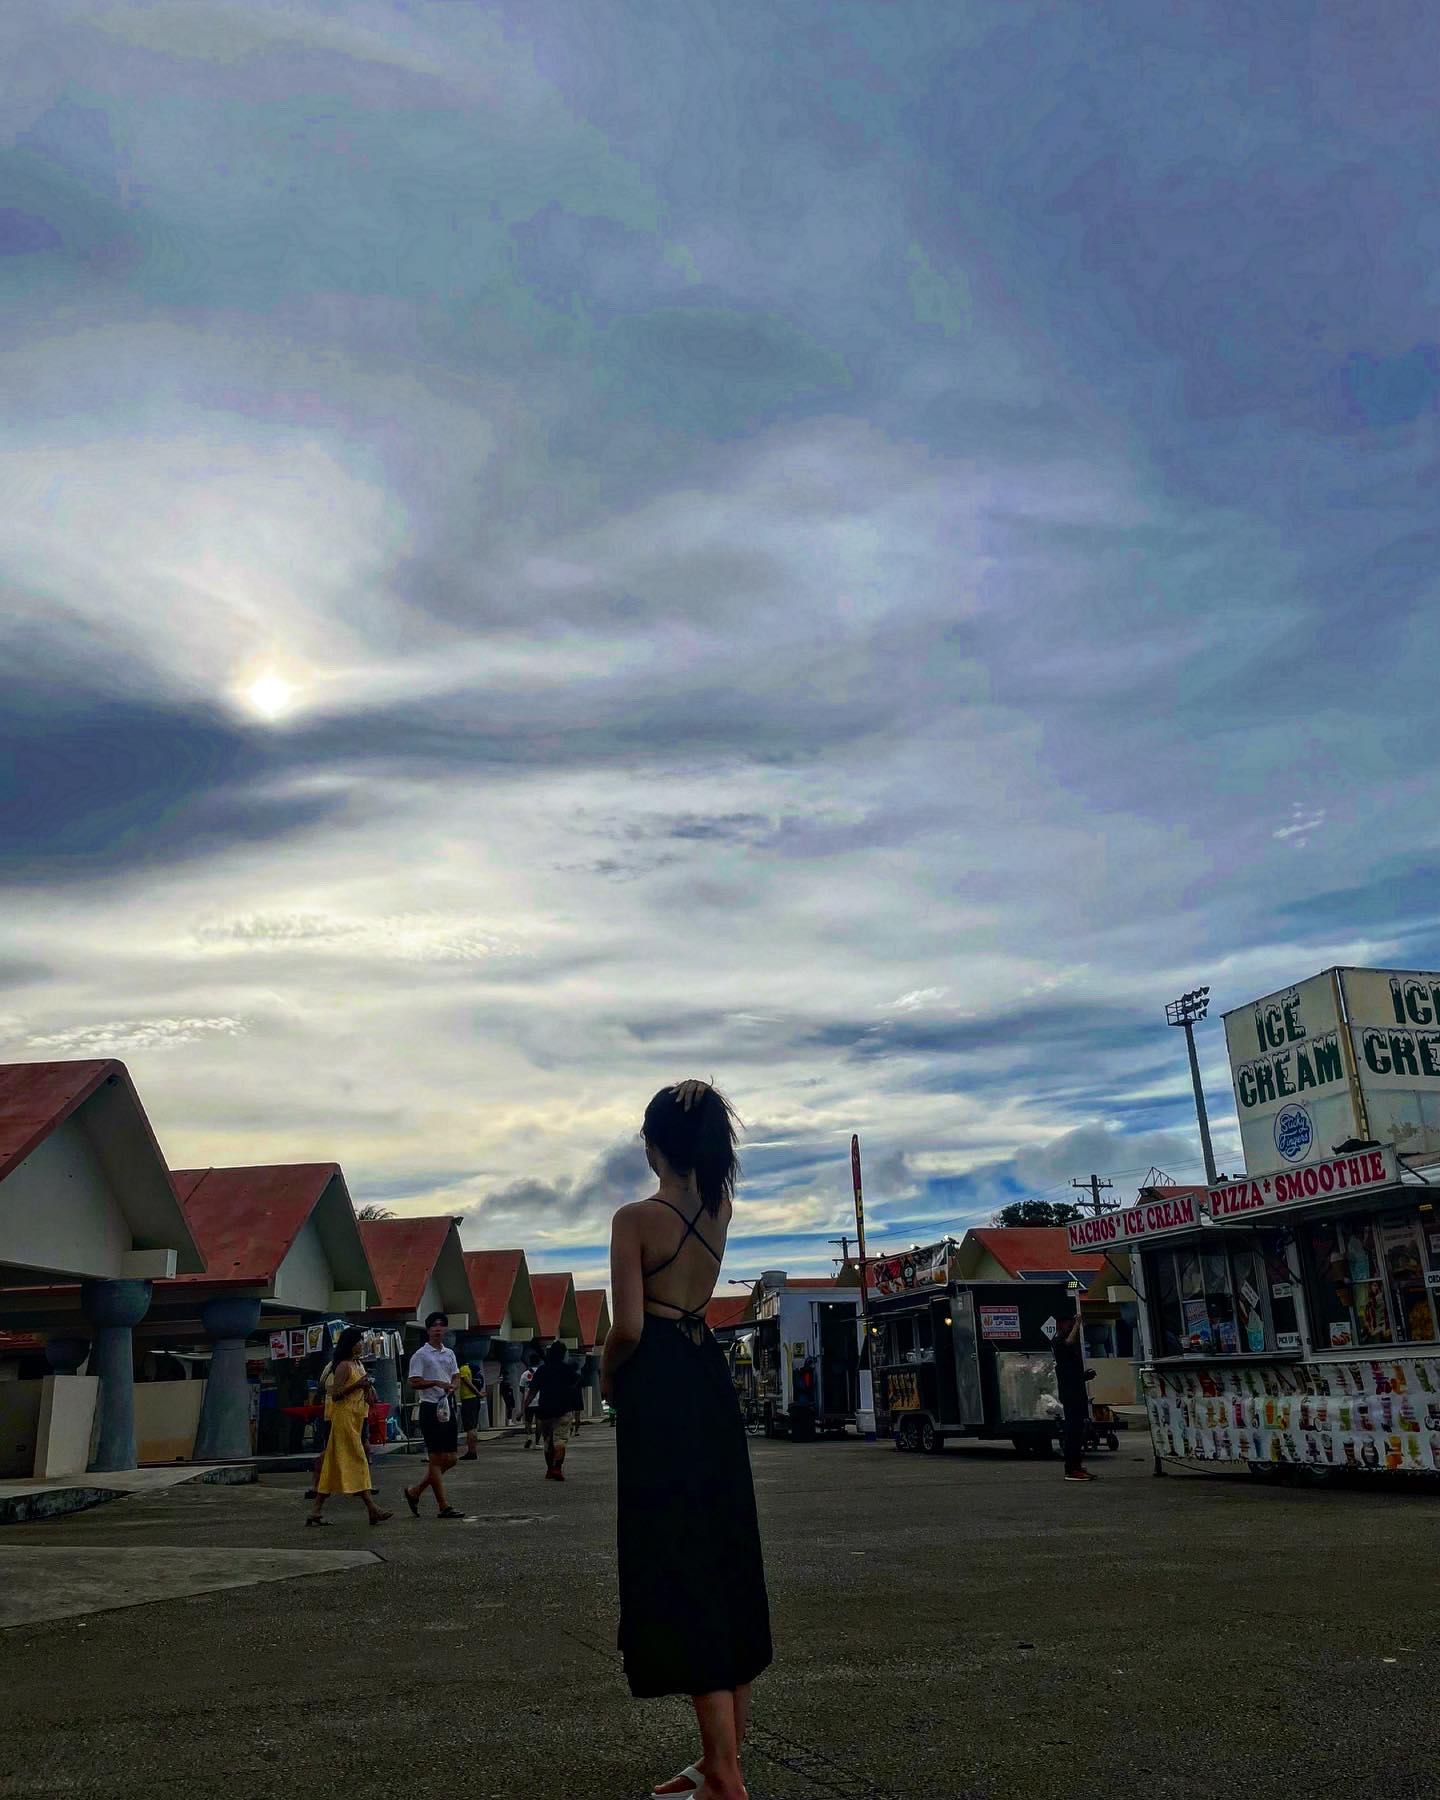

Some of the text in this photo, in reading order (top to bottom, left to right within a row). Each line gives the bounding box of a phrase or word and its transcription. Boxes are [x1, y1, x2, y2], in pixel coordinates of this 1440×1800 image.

[1255, 993, 1306, 1051] ICE
[1237, 1033, 1343, 1108] CREAM
[1279, 1130, 1310, 1157] Fingers
[1280, 1111, 1308, 1133] Sticky
[1209, 1151, 1386, 1216] PIZZA SMOOTHIE
[1069, 1198, 1194, 1246] NACHOS ICE CREAM
